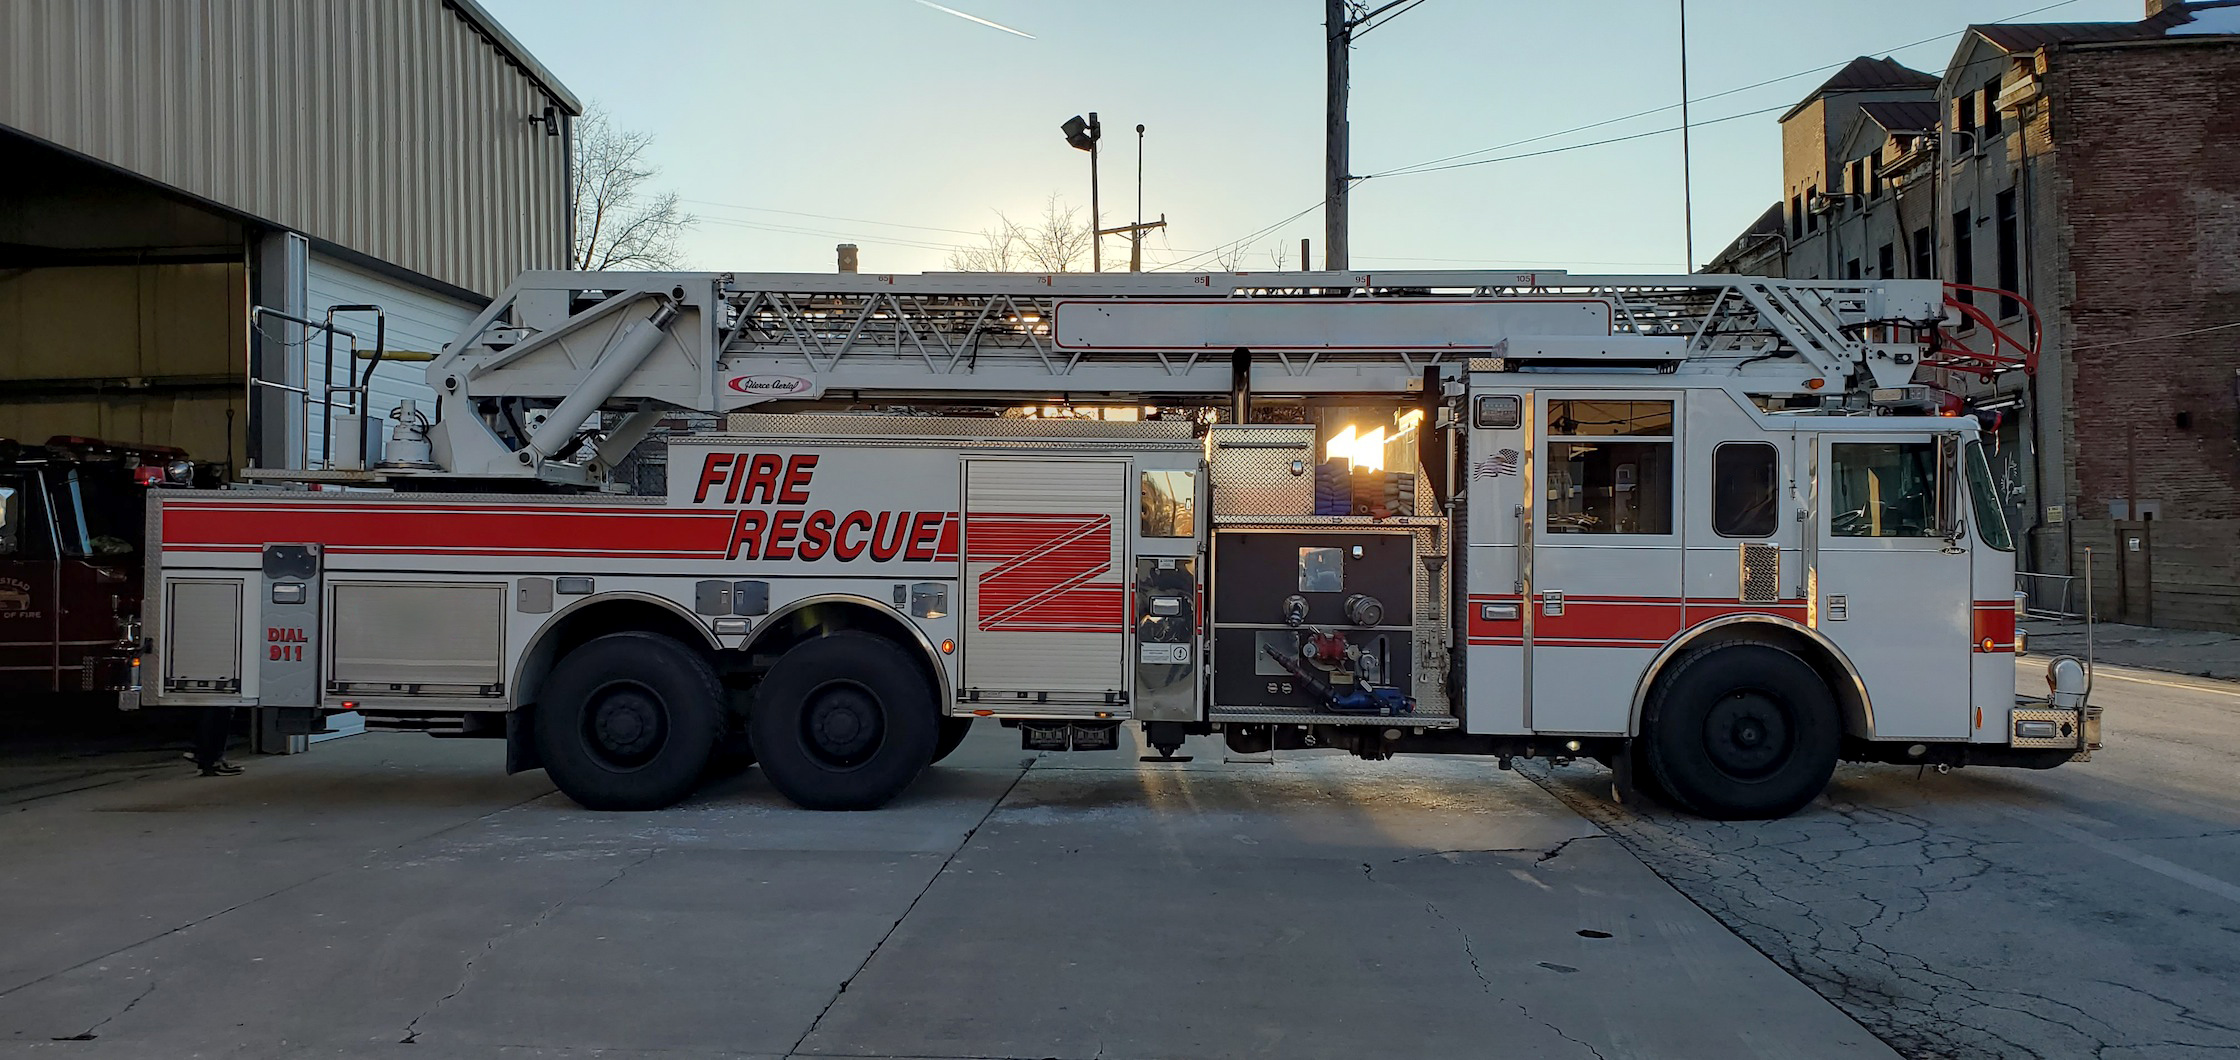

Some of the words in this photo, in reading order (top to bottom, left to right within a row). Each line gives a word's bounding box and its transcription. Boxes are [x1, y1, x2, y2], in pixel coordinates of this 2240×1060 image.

[1036, 275, 1047, 284] 75
[1194, 276, 1205, 284] 85
[1355, 275, 1366, 284] 95
[1516, 275, 1531, 283] 105
[744, 378, 771, 391] Pierce
[693, 452, 820, 505] FIRE
[726, 509, 926, 563] RESCUE
[3, 611, 17, 619] OF
[19, 611, 42, 619] FIRE
[267, 627, 308, 643] DIAL
[269, 645, 302, 662] 911
